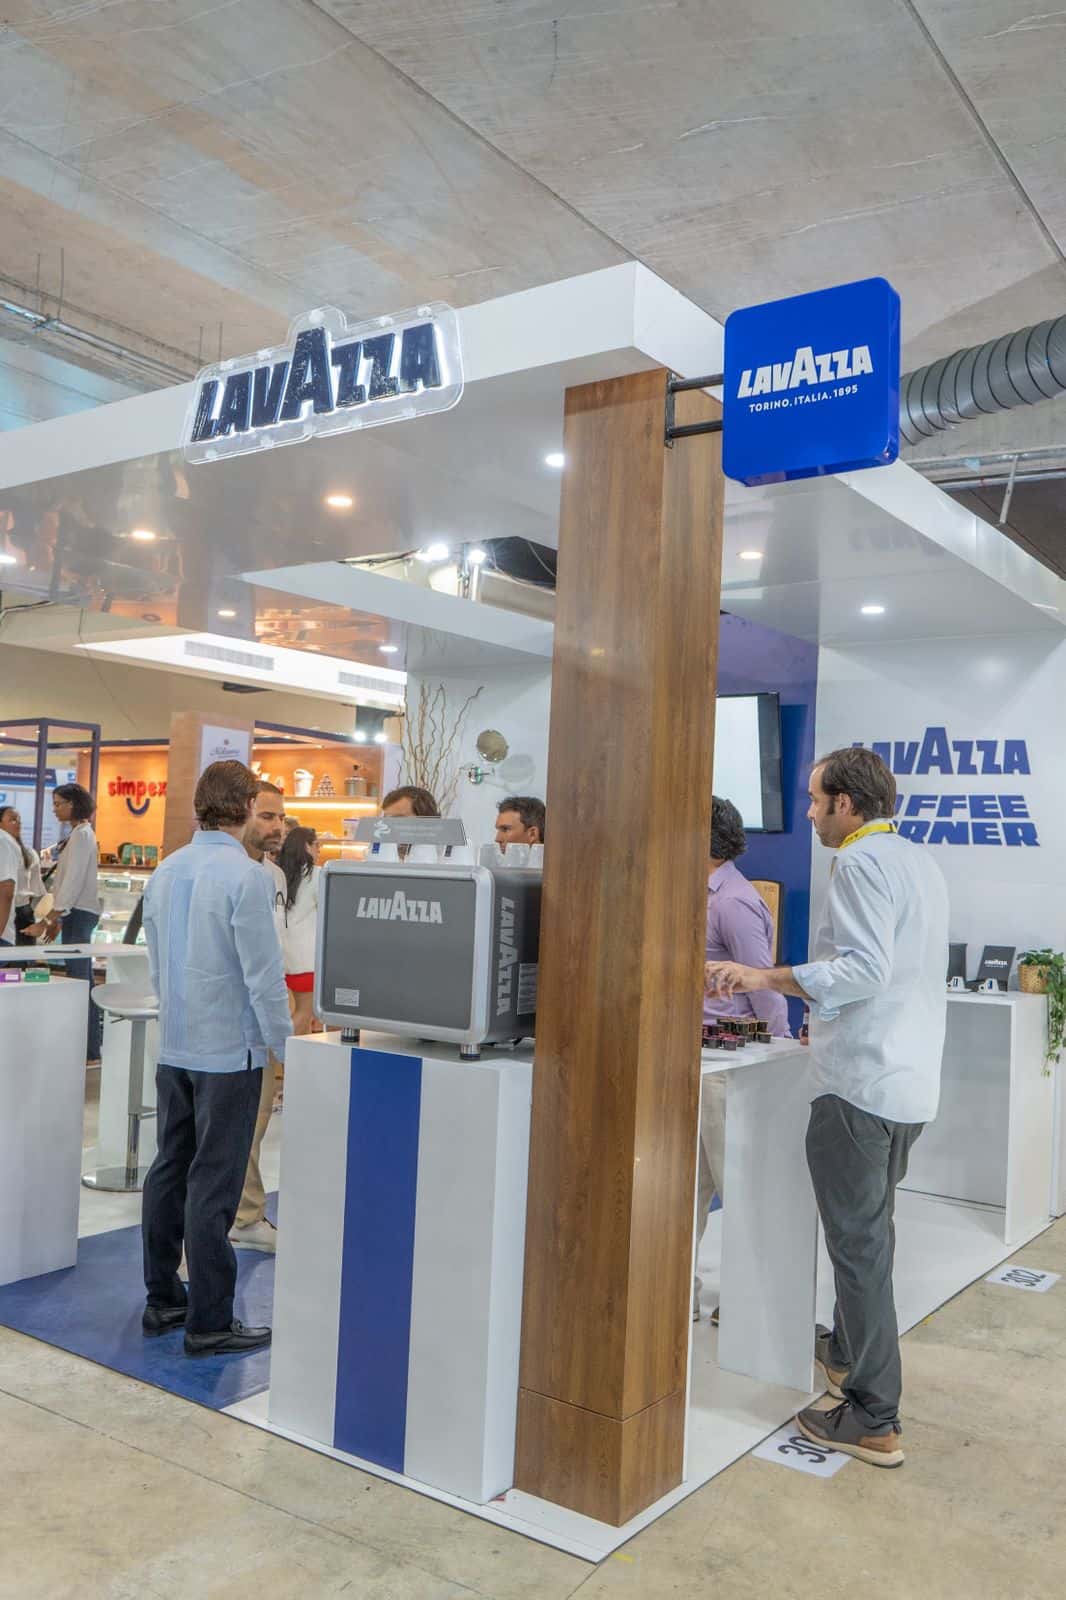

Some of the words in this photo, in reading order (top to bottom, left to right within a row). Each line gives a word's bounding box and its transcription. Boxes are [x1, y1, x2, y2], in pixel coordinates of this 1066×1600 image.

[191, 323, 442, 442] LAVAZZA
[737, 345, 874, 399] LAVAZZA
[833, 384, 858, 398] 1895
[852, 727, 1031, 775] AVAZZA
[108, 776, 168, 806] simpex
[894, 794, 1030, 818] FFEE
[893, 820, 1040, 846] RNER
[356, 890, 443, 924] LAVAZZA
[496, 896, 519, 1016] LAVAZZA
[777, 1434, 837, 1463] 30
